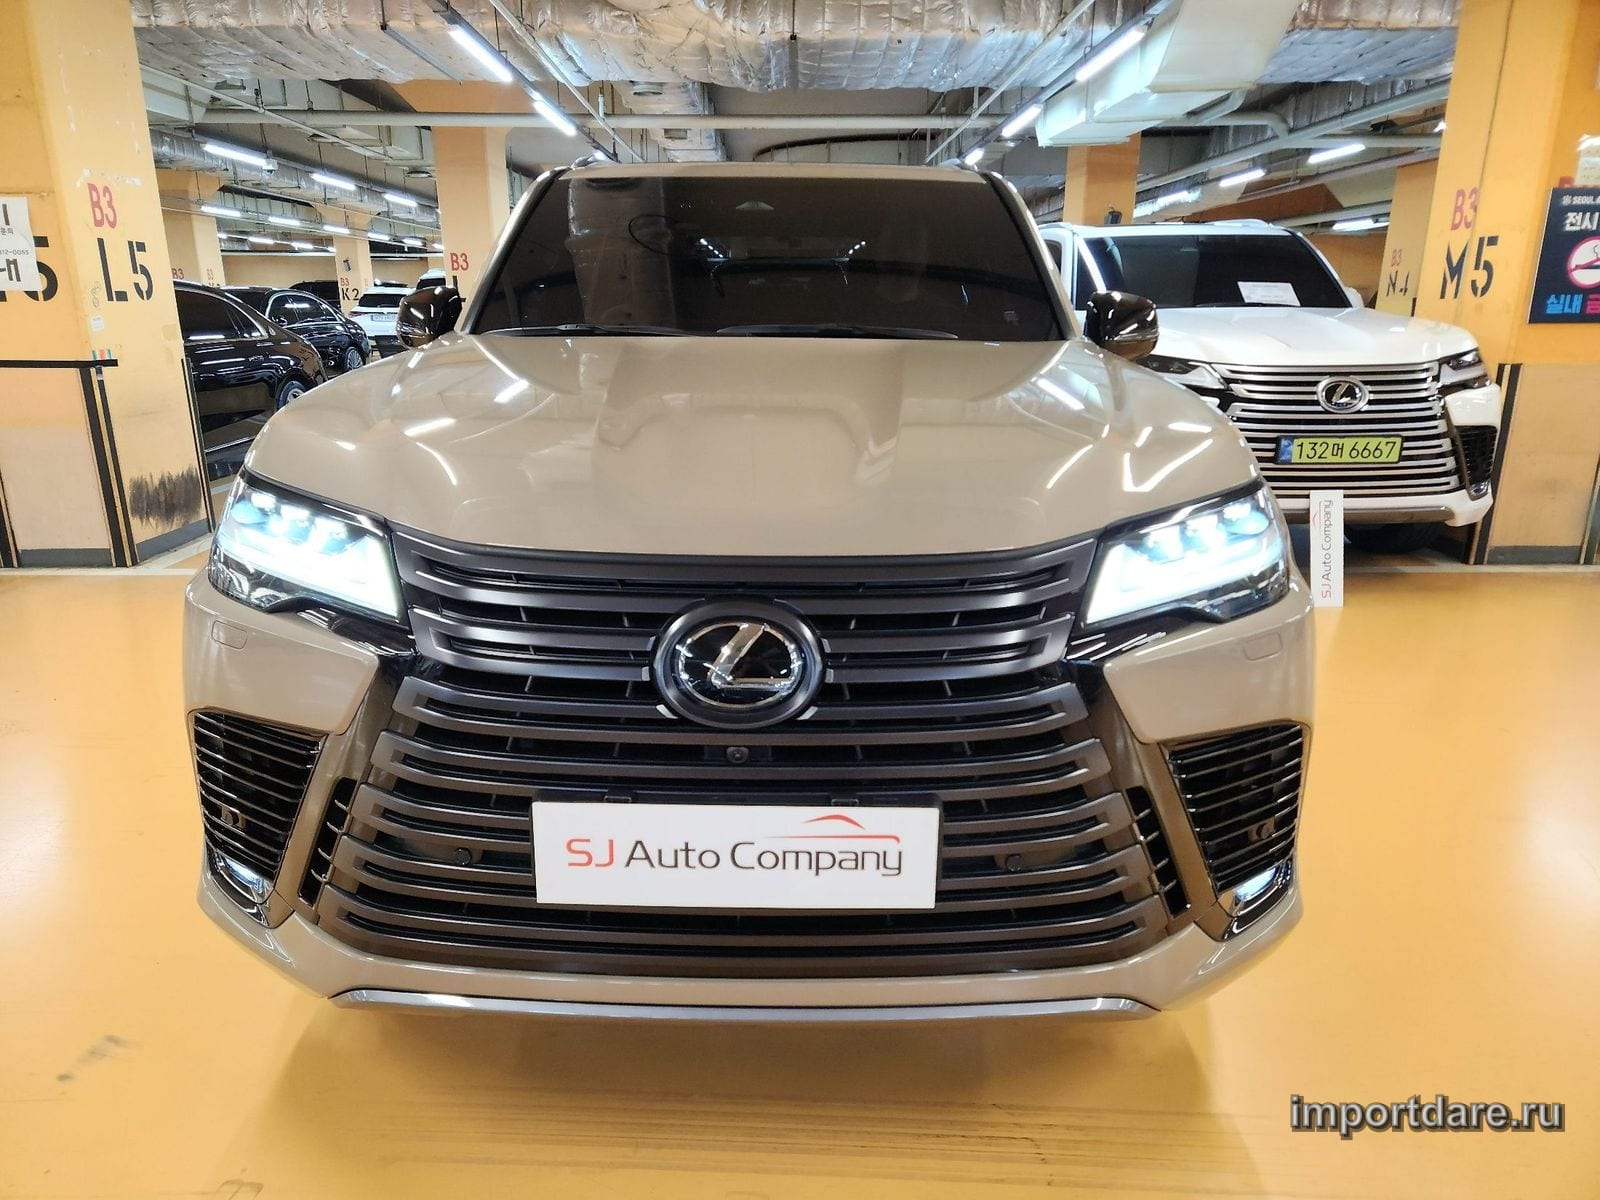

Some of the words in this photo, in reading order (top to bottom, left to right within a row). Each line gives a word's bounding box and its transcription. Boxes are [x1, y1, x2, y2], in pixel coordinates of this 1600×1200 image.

[87, 183, 117, 229] B3
[1451, 187, 1479, 231] B3
[1565, 212, 1600, 231] 전시
[97, 237, 153, 302] L5
[171, 268, 184, 280] B3
[450, 252, 469, 271] B3
[1440, 236, 1499, 300] M5
[340, 278, 350, 287] B3
[1321, 499, 1334, 551] Company
[1321, 552, 1332, 581] Auto
[1321, 583, 1332, 599] SJ
[565, 838, 615, 868] SJ
[624, 839, 721, 870] Auto
[730, 841, 903, 877] Company
